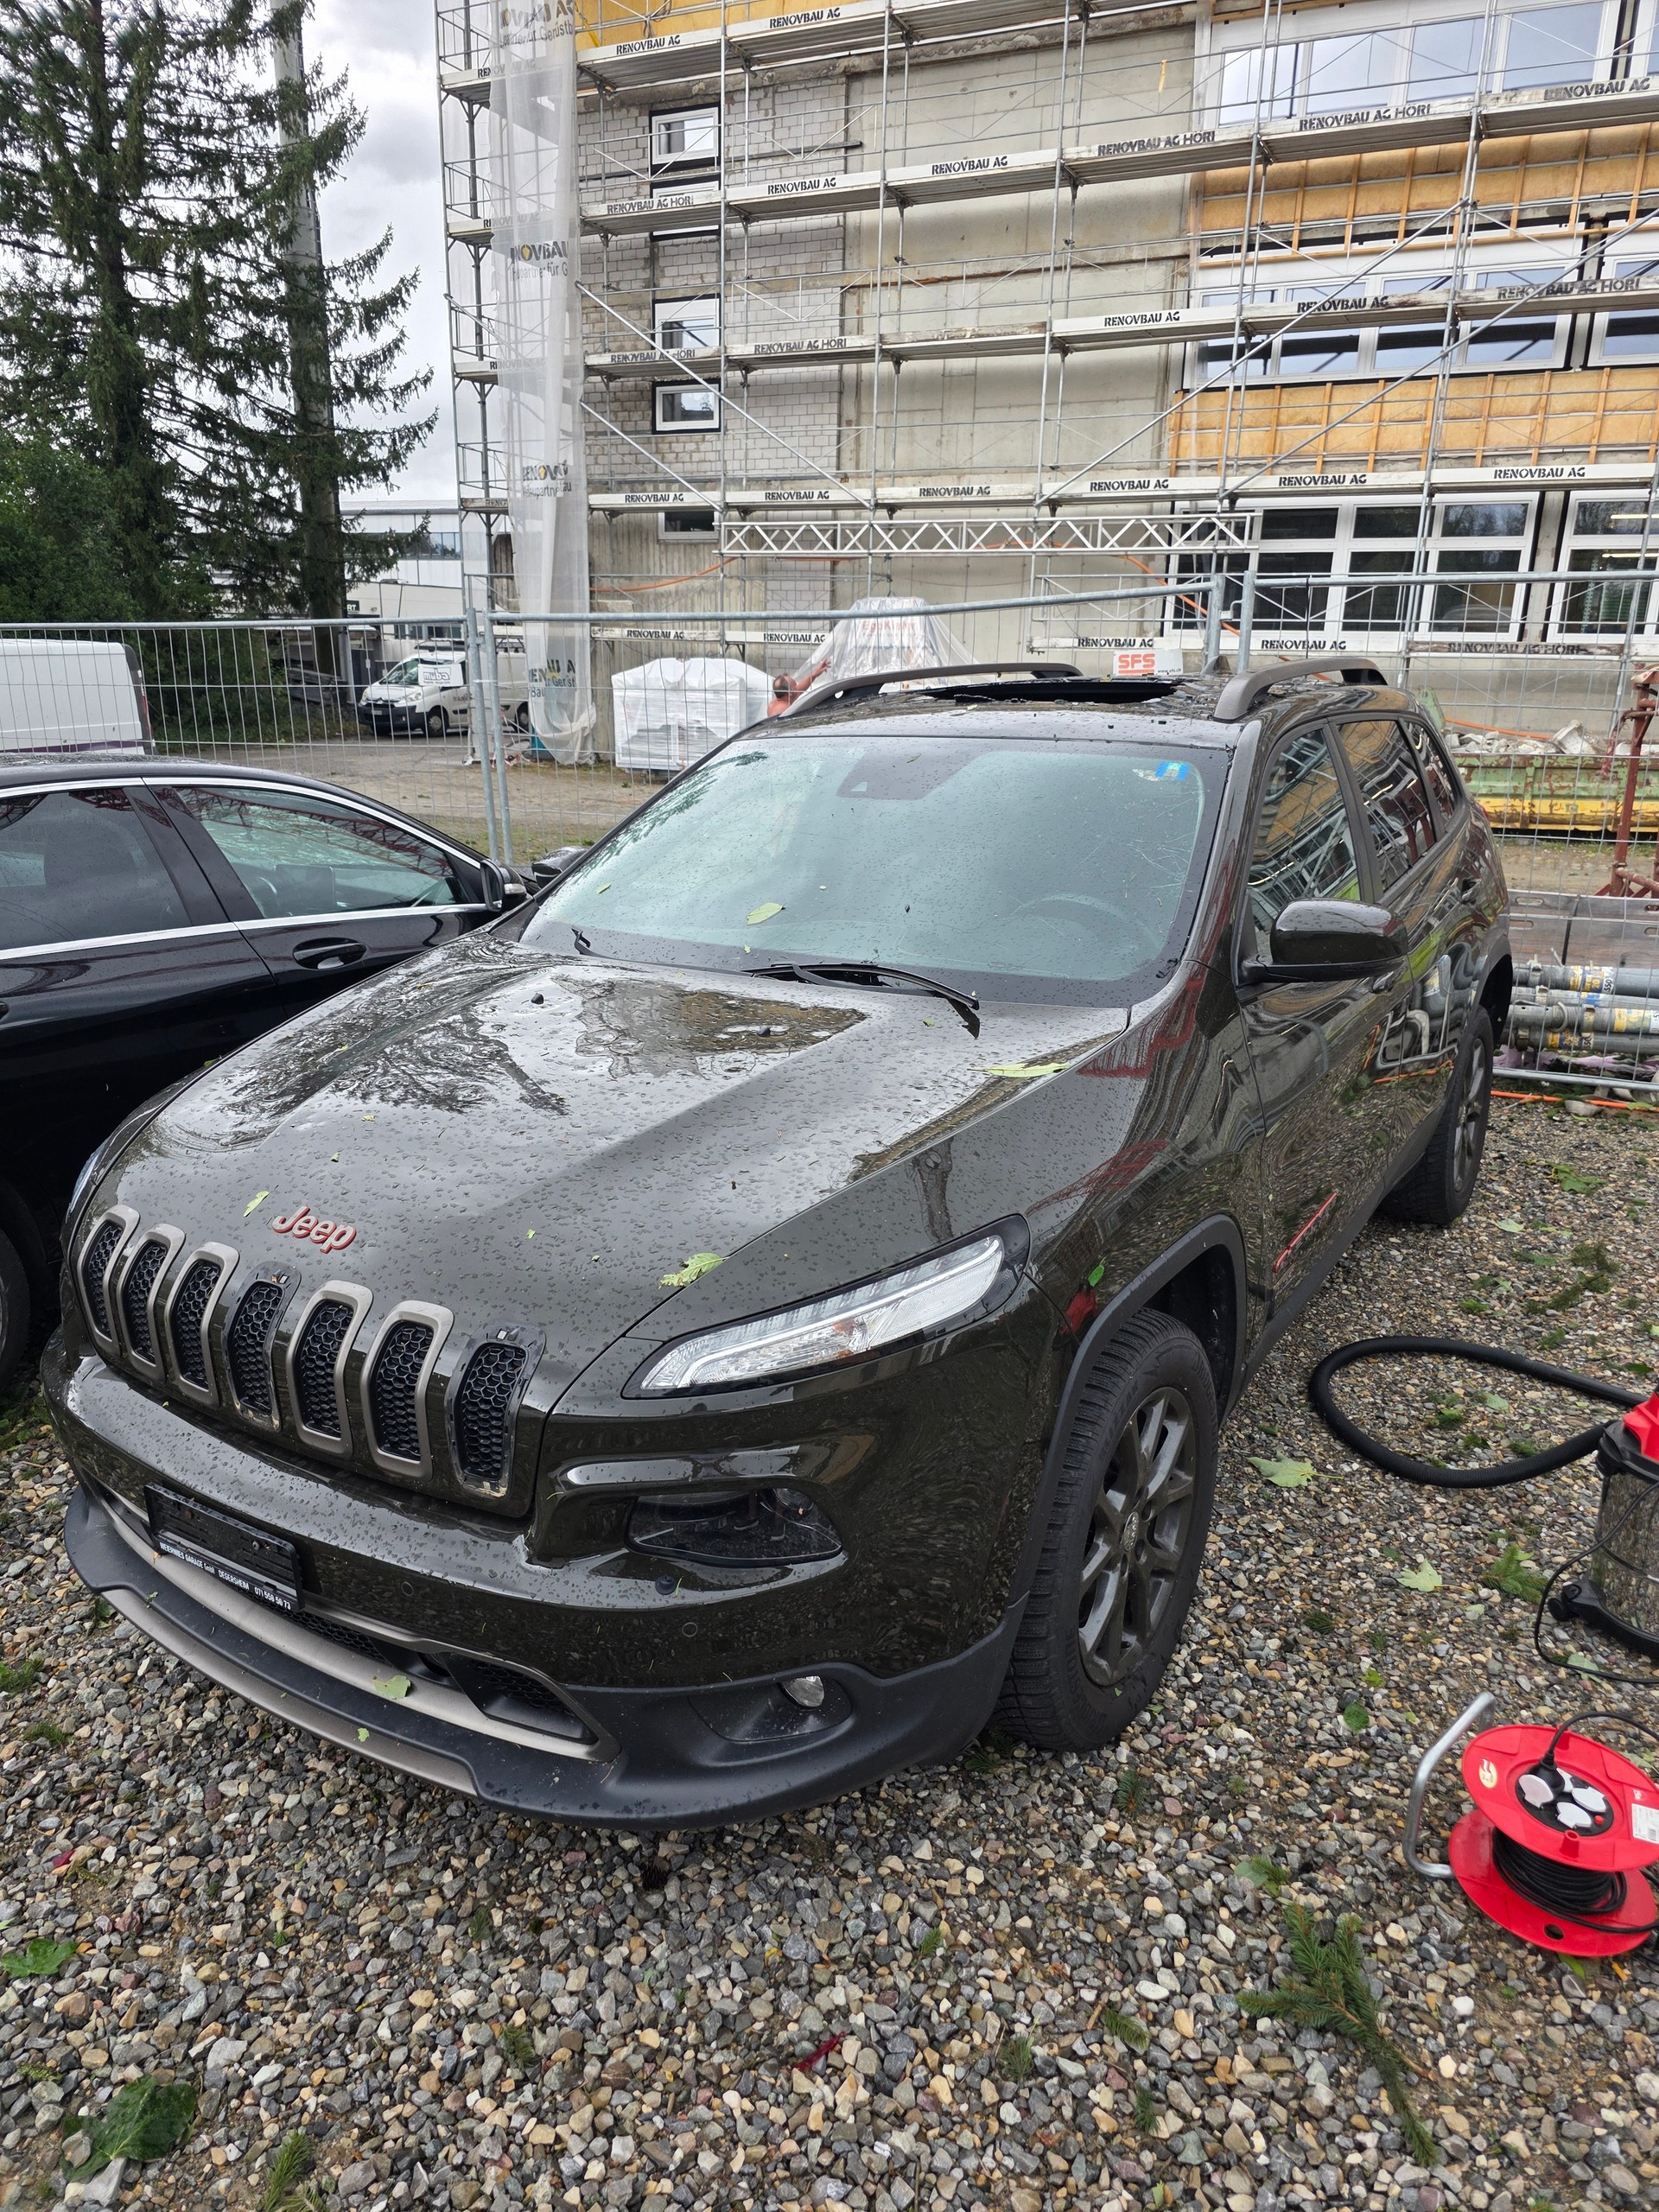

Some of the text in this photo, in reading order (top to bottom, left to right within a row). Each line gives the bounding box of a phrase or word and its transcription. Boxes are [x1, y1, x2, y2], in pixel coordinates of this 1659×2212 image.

[769, 8, 841, 29] RENOVBAU AG
[616, 35, 681, 55] RENOVBAU AG
[1629, 77, 1650, 91] AG
[1300, 111, 1370, 131] RENOVBAU
[1373, 109, 1391, 121] AG
[1097, 137, 1160, 156] RENOVBAU
[1162, 135, 1179, 147] AG
[931, 156, 1007, 175] RENOVBAU AG
[767, 177, 836, 194] RENOVBAU AG
[607, 199, 654, 214] RENOVBAU
[656, 199, 669, 208] AG
[1577, 281, 1598, 293] AG
[1370, 296, 1389, 309] AG
[1103, 311, 1180, 327] RENOVBAU AG
[754, 341, 805, 353] RENOVBAU
[807, 340, 820, 350] AG
[611, 351, 656, 364] RENOVBAU
[1278, 474, 1367, 486] RENOVBAU AG
[1493, 467, 1586, 480] RENOVBAU AG
[918, 486, 991, 498] RENOVBAU AG
[1090, 480, 1168, 493] RENOVBAU AG
[625, 493, 684, 504] RENOVBAU AG
[765, 491, 830, 501] RENOVBAU AG
[626, 629, 671, 639] RENOVBAU
[672, 631, 684, 640] AG
[763, 632, 826, 643] RENOVBAU AG
[1077, 639, 1154, 648] RENOVBAU AG
[1262, 639, 1346, 651] RENOVBAU AG
[1118, 653, 1155, 669] SFS
[1604, 979, 1612, 993] 550
[272, 1205, 357, 1254] Jeep
[185, 1554, 204, 1569] GARAGE
[218, 1569, 250, 1590] DEGERSHEIM
